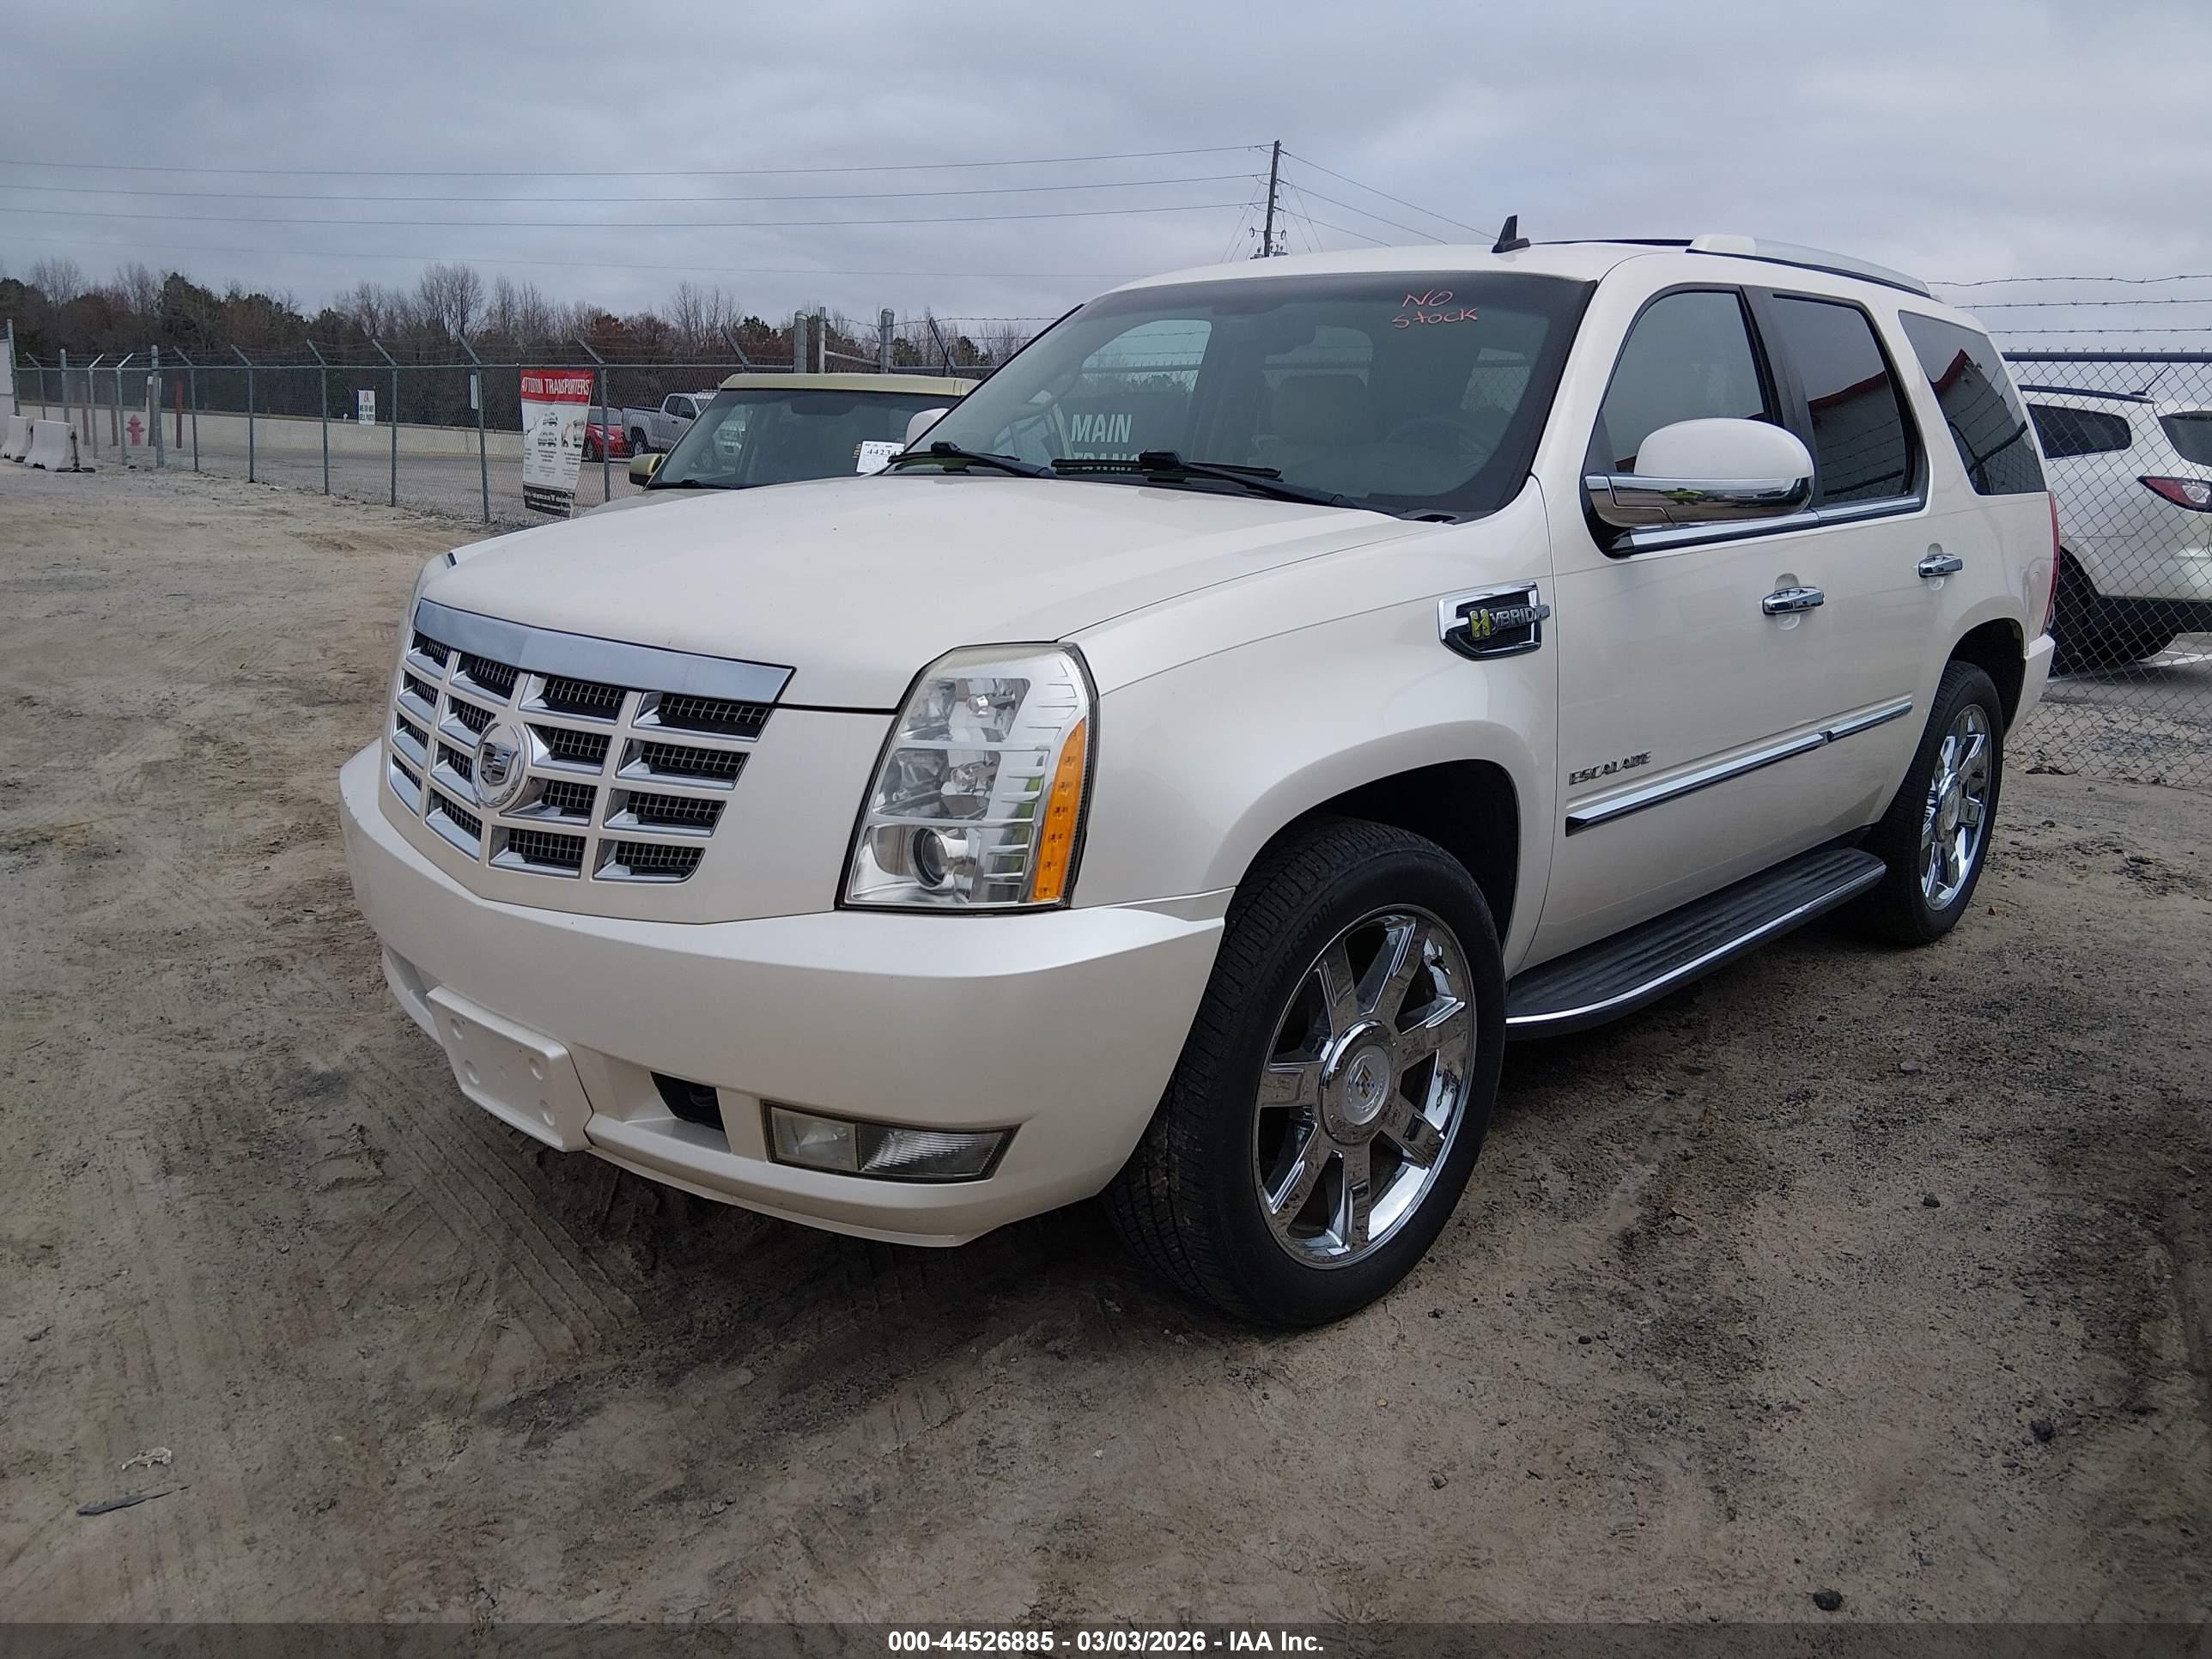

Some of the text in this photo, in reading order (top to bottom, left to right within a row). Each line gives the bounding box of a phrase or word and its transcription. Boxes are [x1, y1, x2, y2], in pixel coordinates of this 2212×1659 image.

[1401, 289, 1454, 308] NO
[1071, 414, 1133, 443] MAIN
[1469, 607, 1535, 639] HYBRID
[1569, 751, 1651, 786] ESCALADE
